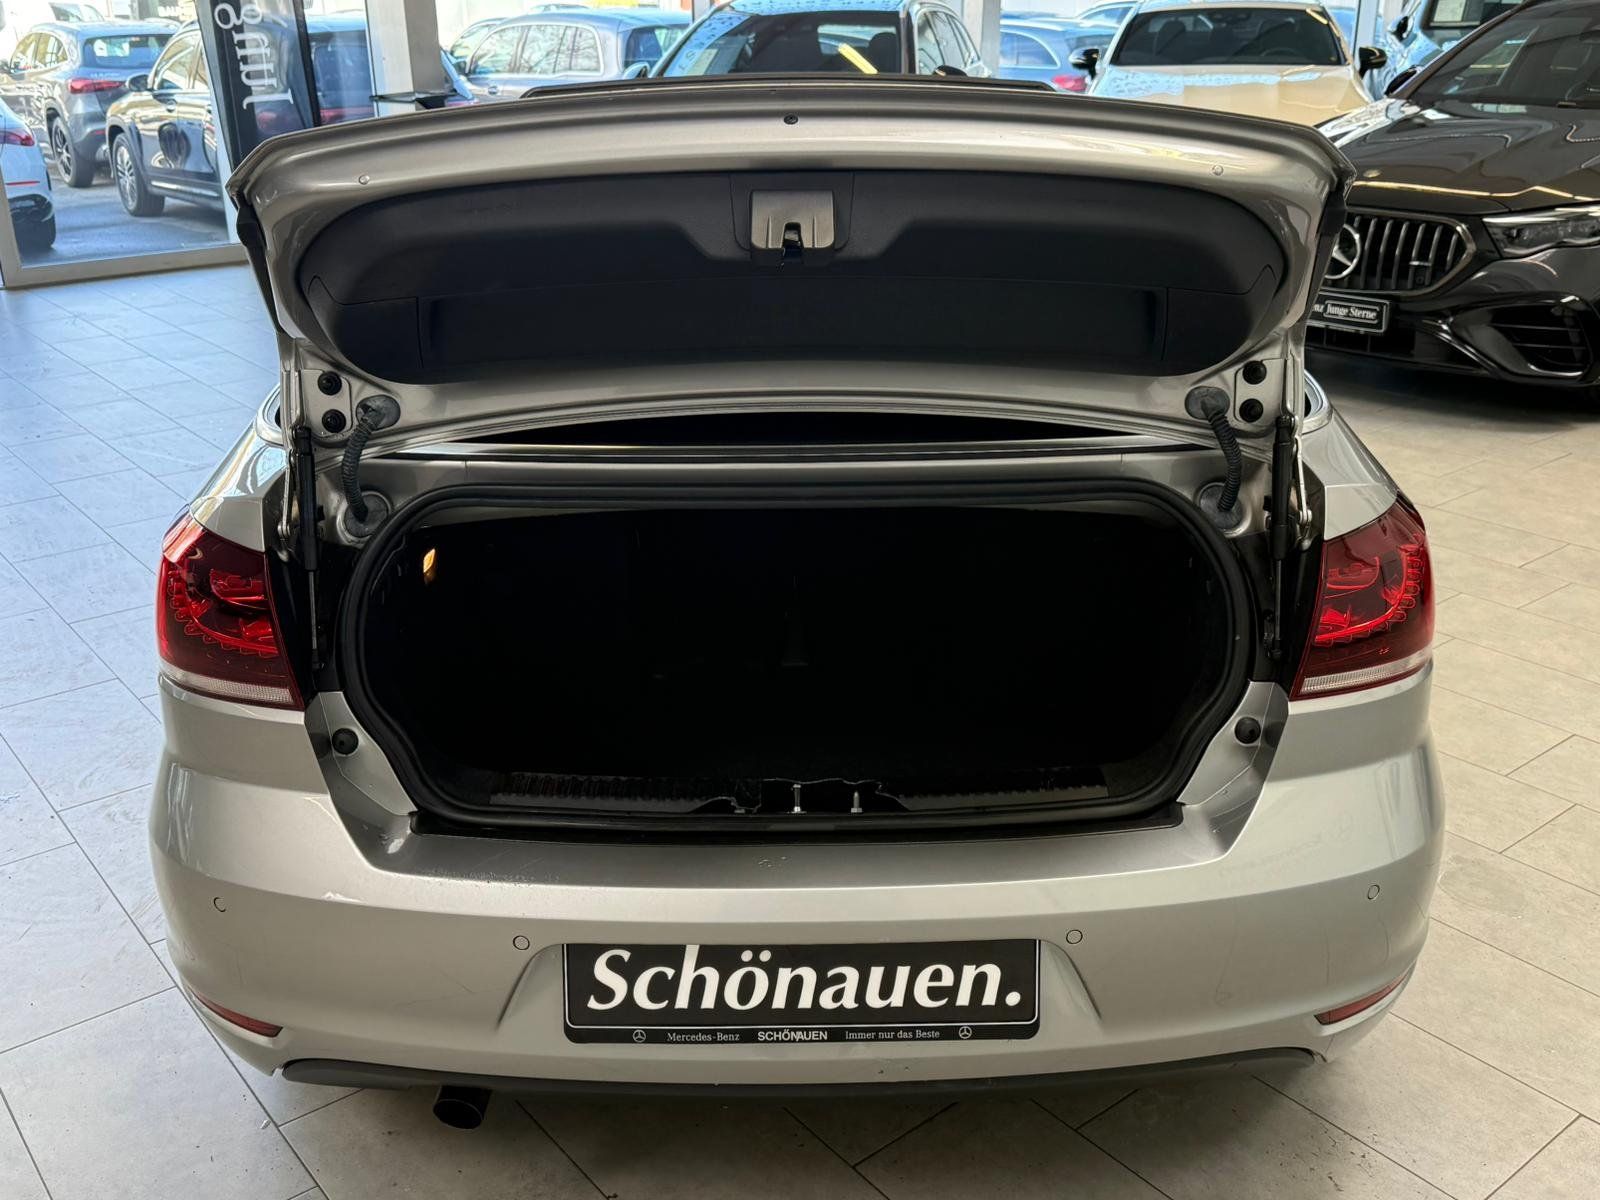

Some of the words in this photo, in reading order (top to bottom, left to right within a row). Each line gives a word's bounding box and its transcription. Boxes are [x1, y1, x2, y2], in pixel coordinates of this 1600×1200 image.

[1326, 303, 1348, 316] Junge
[1349, 306, 1377, 319] Sterne
[587, 944, 1022, 1011] Schönauen.
[666, 1031, 740, 1042] Mercedes-Benz
[757, 1029, 828, 1041] SCHÖNAUEN
[845, 1031, 875, 1040] Immer
[878, 1031, 894, 1040] nur
[896, 1030, 913, 1039] das
[915, 1030, 940, 1039] Beste
